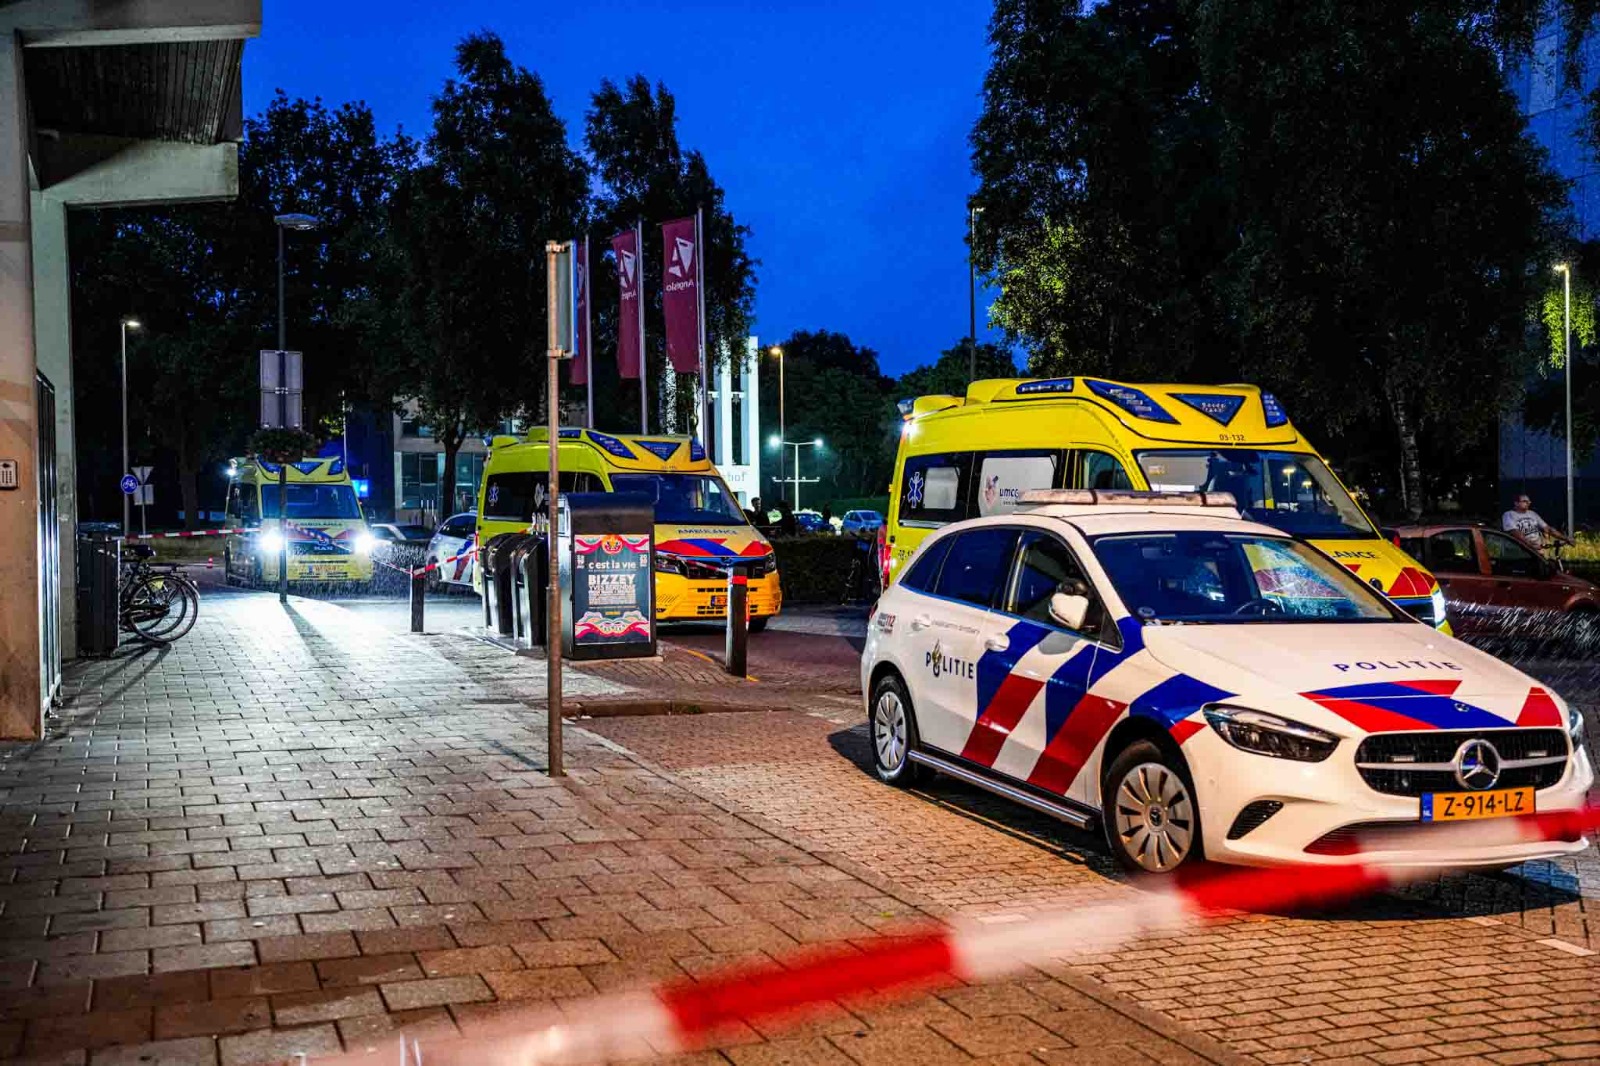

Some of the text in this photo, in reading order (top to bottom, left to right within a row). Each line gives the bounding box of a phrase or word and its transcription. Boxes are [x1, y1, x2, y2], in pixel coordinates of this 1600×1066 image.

[611, 559, 620, 569] la
[622, 561, 636, 569] vie
[588, 574, 636, 585] BIZZEY
[925, 651, 974, 679] POLITIE
[1333, 660, 1463, 672] POLITIE
[1443, 791, 1524, 817] Z-914-LZ
